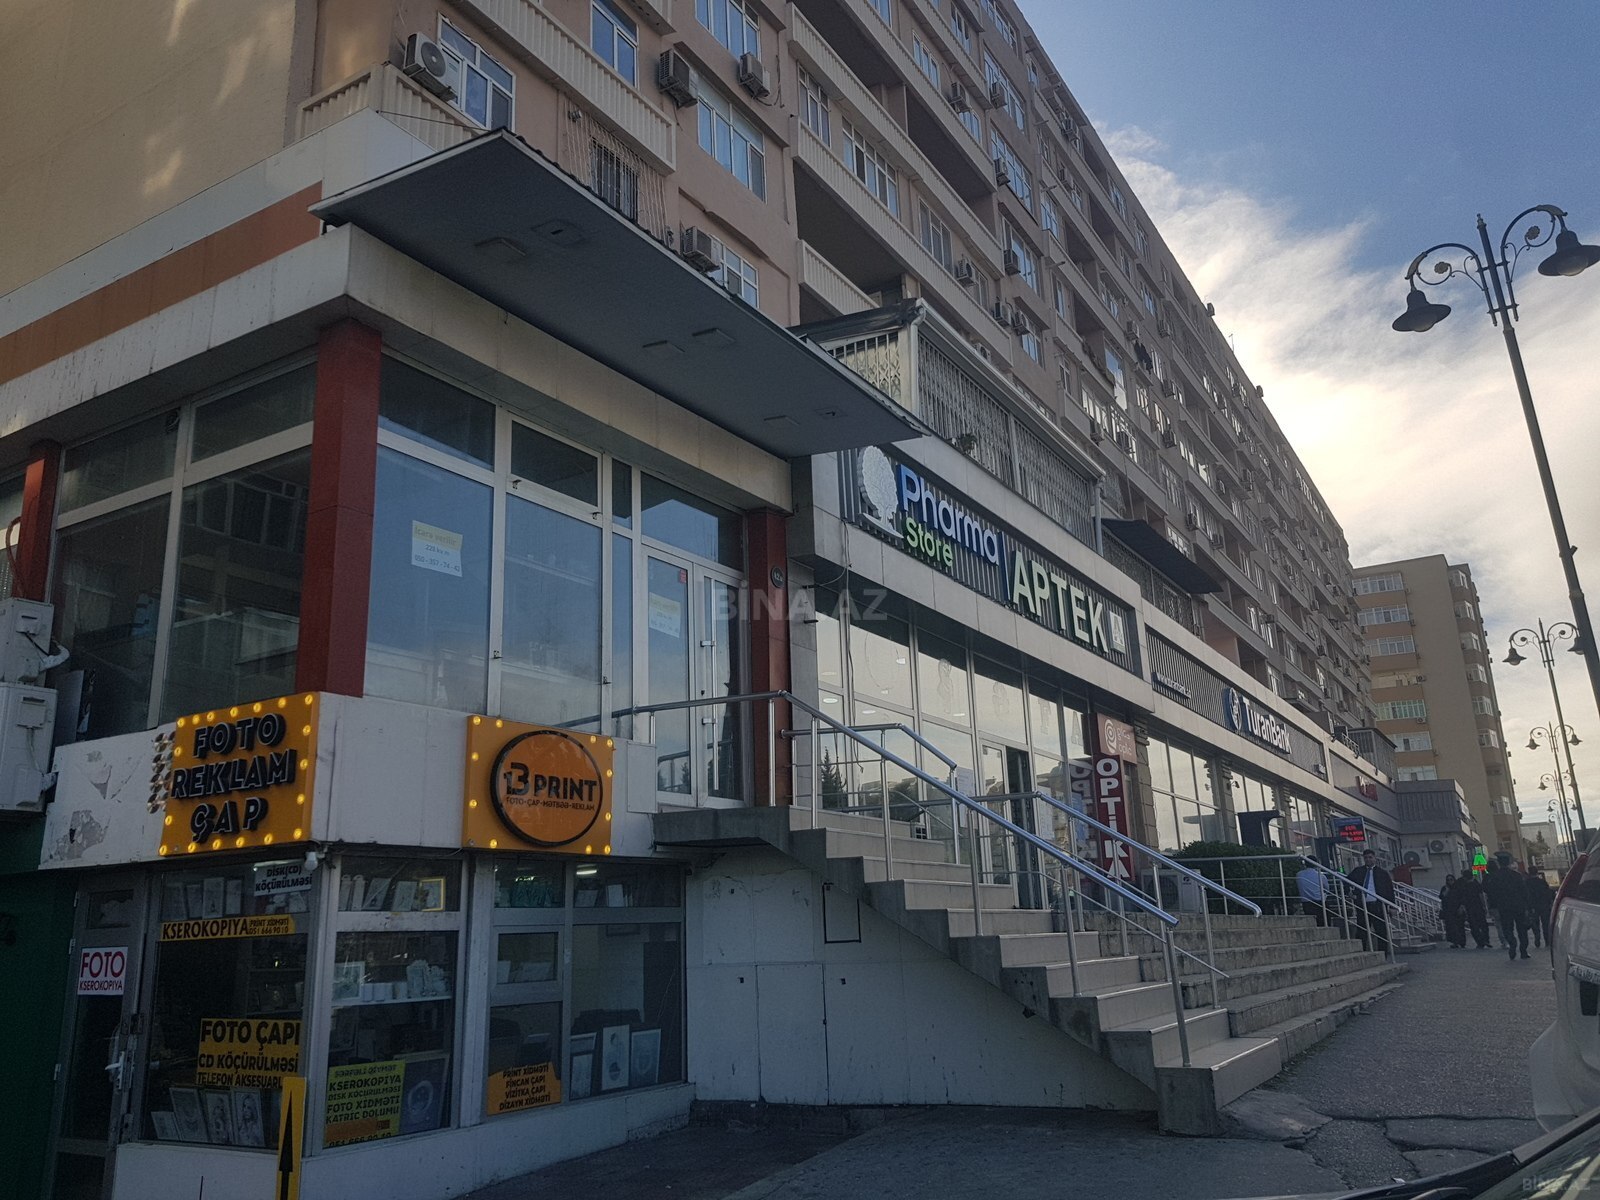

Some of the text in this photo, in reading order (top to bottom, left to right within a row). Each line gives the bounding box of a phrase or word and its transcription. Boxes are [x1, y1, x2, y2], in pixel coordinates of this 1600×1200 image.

[899, 463, 999, 566] Pharma
[1011, 549, 1109, 653] APTEK
[193, 713, 287, 759] FOTO
[1242, 695, 1292, 754] TuranBank
[171, 748, 297, 800] REKLAM
[533, 774, 598, 802] PRINT
[191, 797, 269, 843] ÇAP
[162, 918, 249, 939] KSEROKOPIYA
[80, 951, 125, 978] FOTO
[79, 979, 122, 991] KSEROKOPIYA
[200, 1020, 301, 1050] FOTO ÇAPI
[198, 1051, 299, 1073] CD KÖÇÜRÜLMƏSİ
[197, 1072, 234, 1085] TELEFON
[327, 1103, 353, 1117] FOTO
